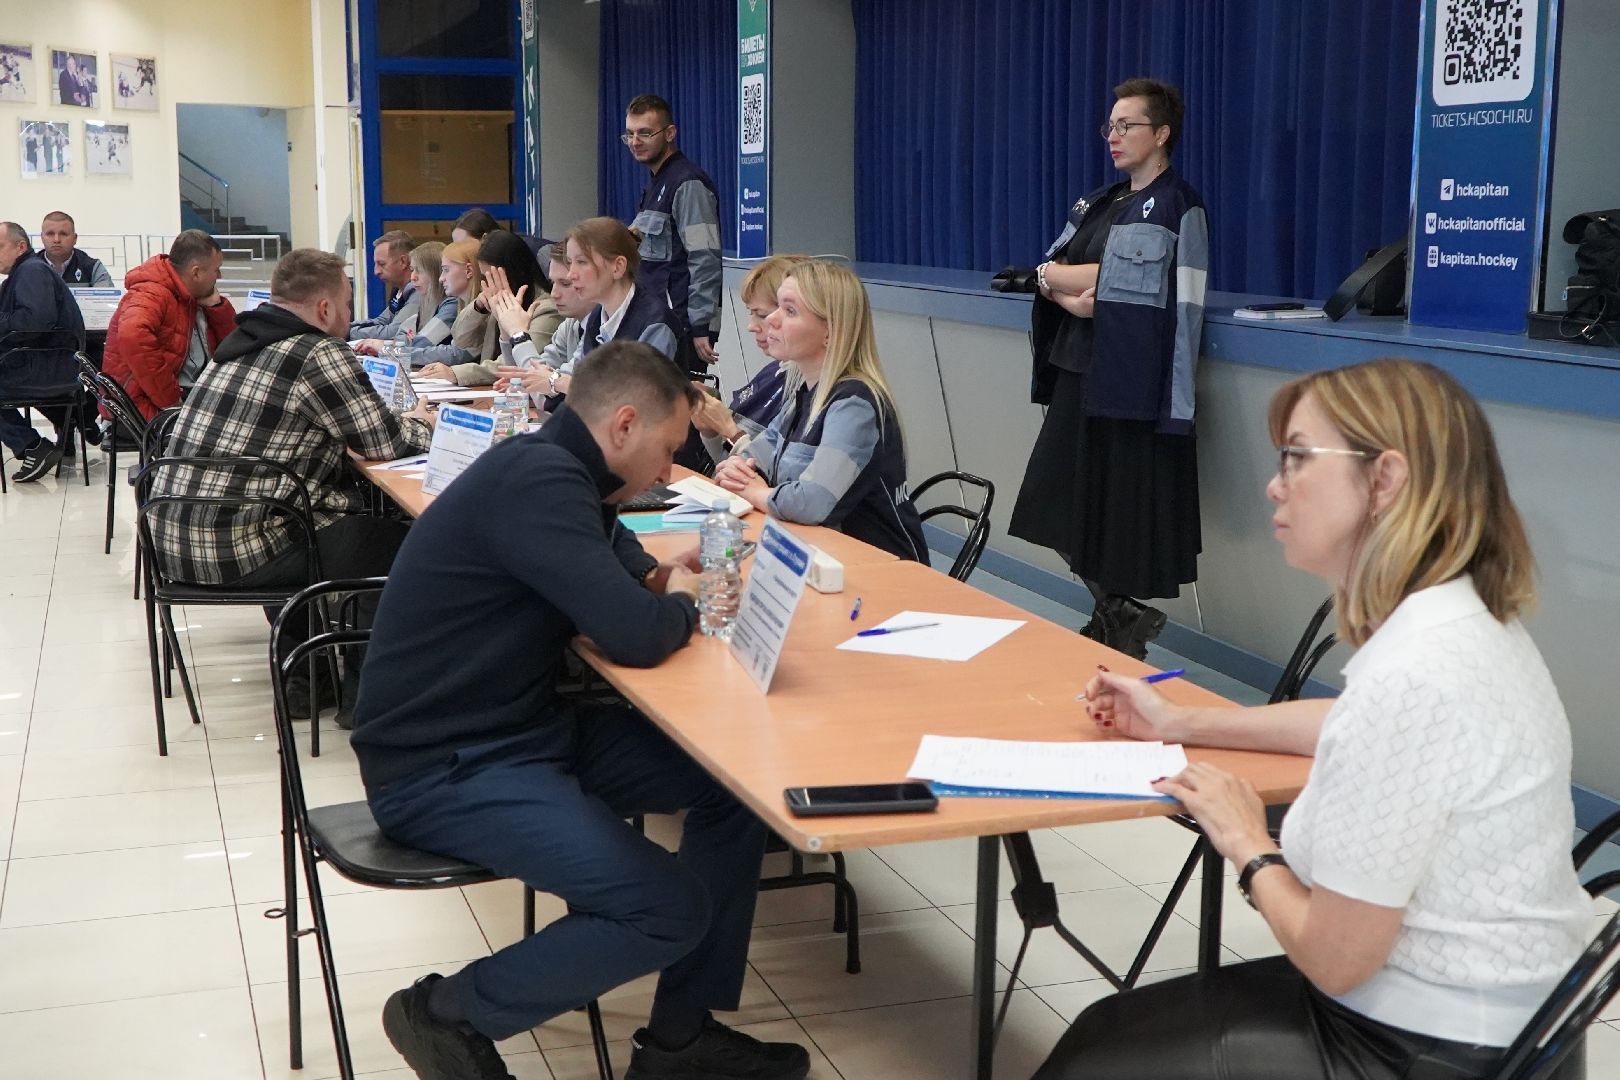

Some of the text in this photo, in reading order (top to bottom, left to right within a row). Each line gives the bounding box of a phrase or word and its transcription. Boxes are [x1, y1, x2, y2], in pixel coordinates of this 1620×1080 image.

[1432, 109, 1533, 129] TICKETS.HCSOCHI.RU
[1456, 183, 1509, 199] hckapitan
[1438, 217, 1526, 232] hckapitanofficial
[1440, 252, 1519, 270] kapitan.hockey
